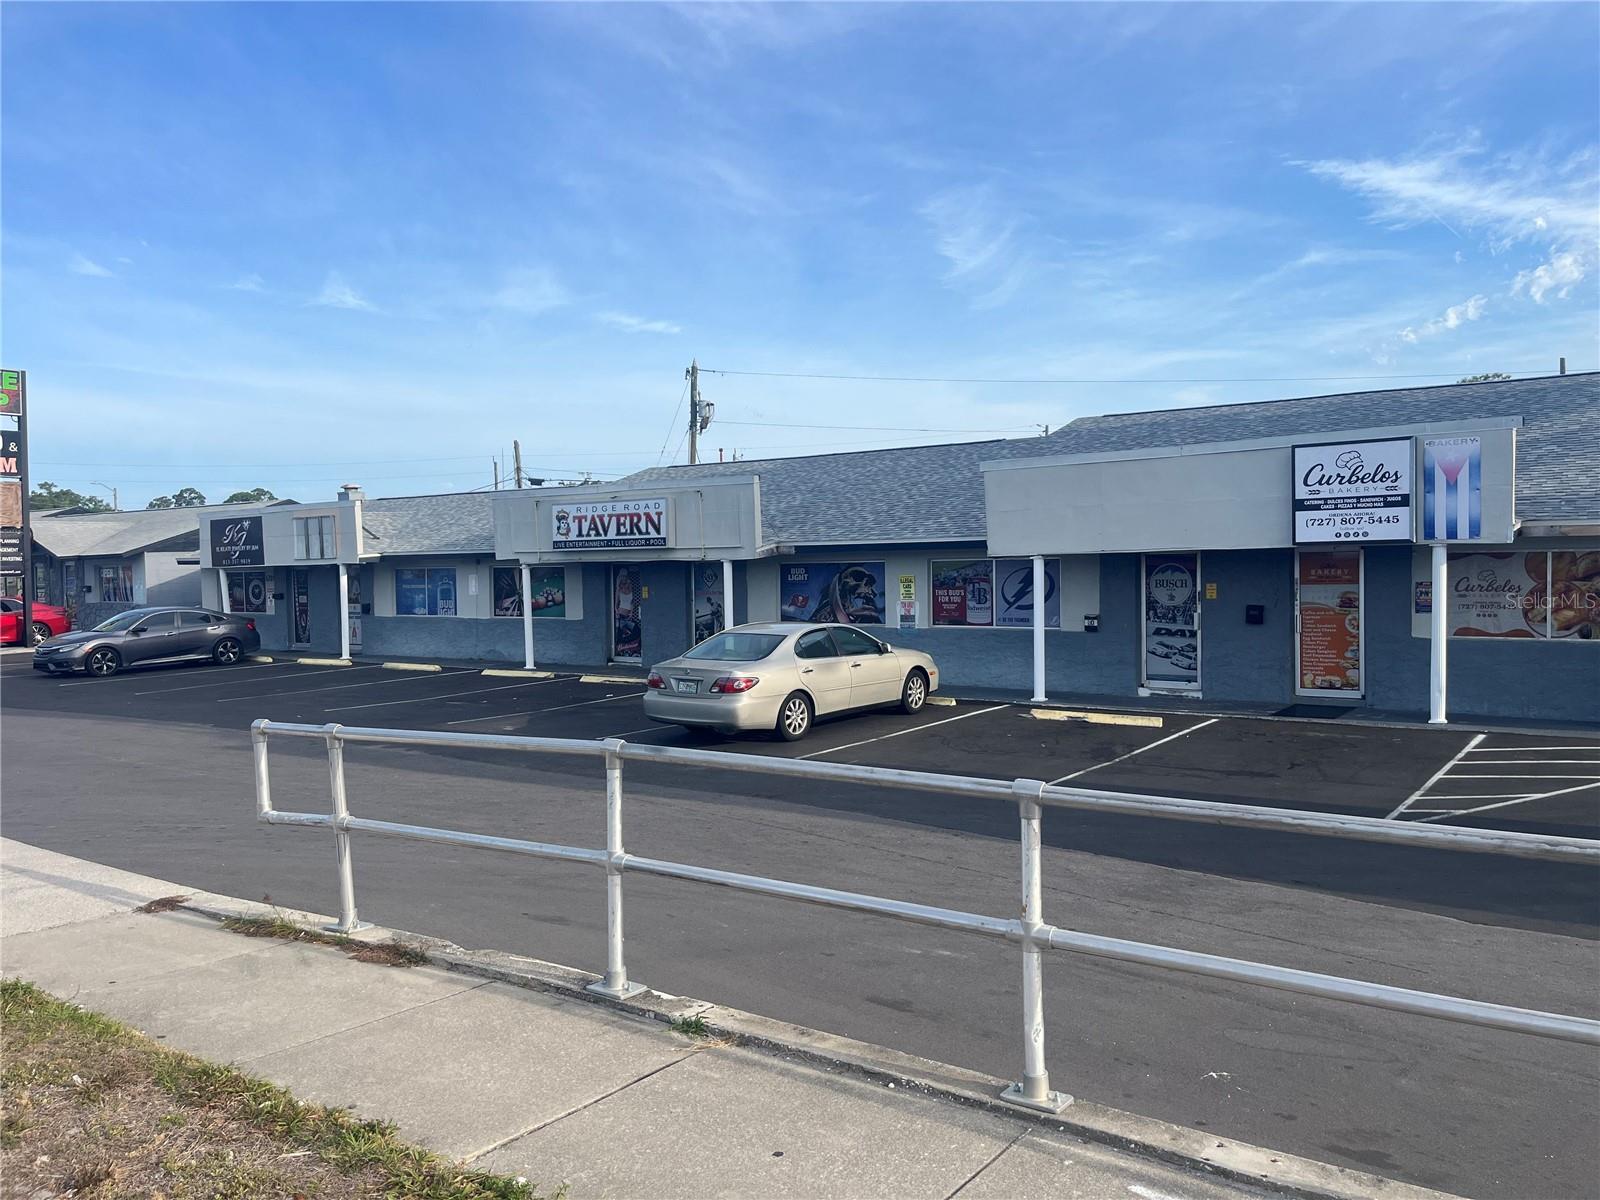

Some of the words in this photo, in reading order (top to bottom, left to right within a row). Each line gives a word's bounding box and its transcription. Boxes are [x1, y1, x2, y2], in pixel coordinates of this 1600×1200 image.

[1428, 437, 1476, 447] BAKERY
[1302, 463, 1402, 487] Curbelos
[1328, 486, 1378, 495] BAKERY
[576, 505, 617, 513] RIDGE
[623, 502, 661, 511] ROAD
[572, 511, 663, 538] TAVERN
[1305, 518, 1336, 528] (727)
[1340, 515, 1400, 526] 807-5445
[790, 567, 806, 575] BUD
[1154, 579, 1188, 589] BUSCH
[1454, 576, 1523, 593] Curbelos
